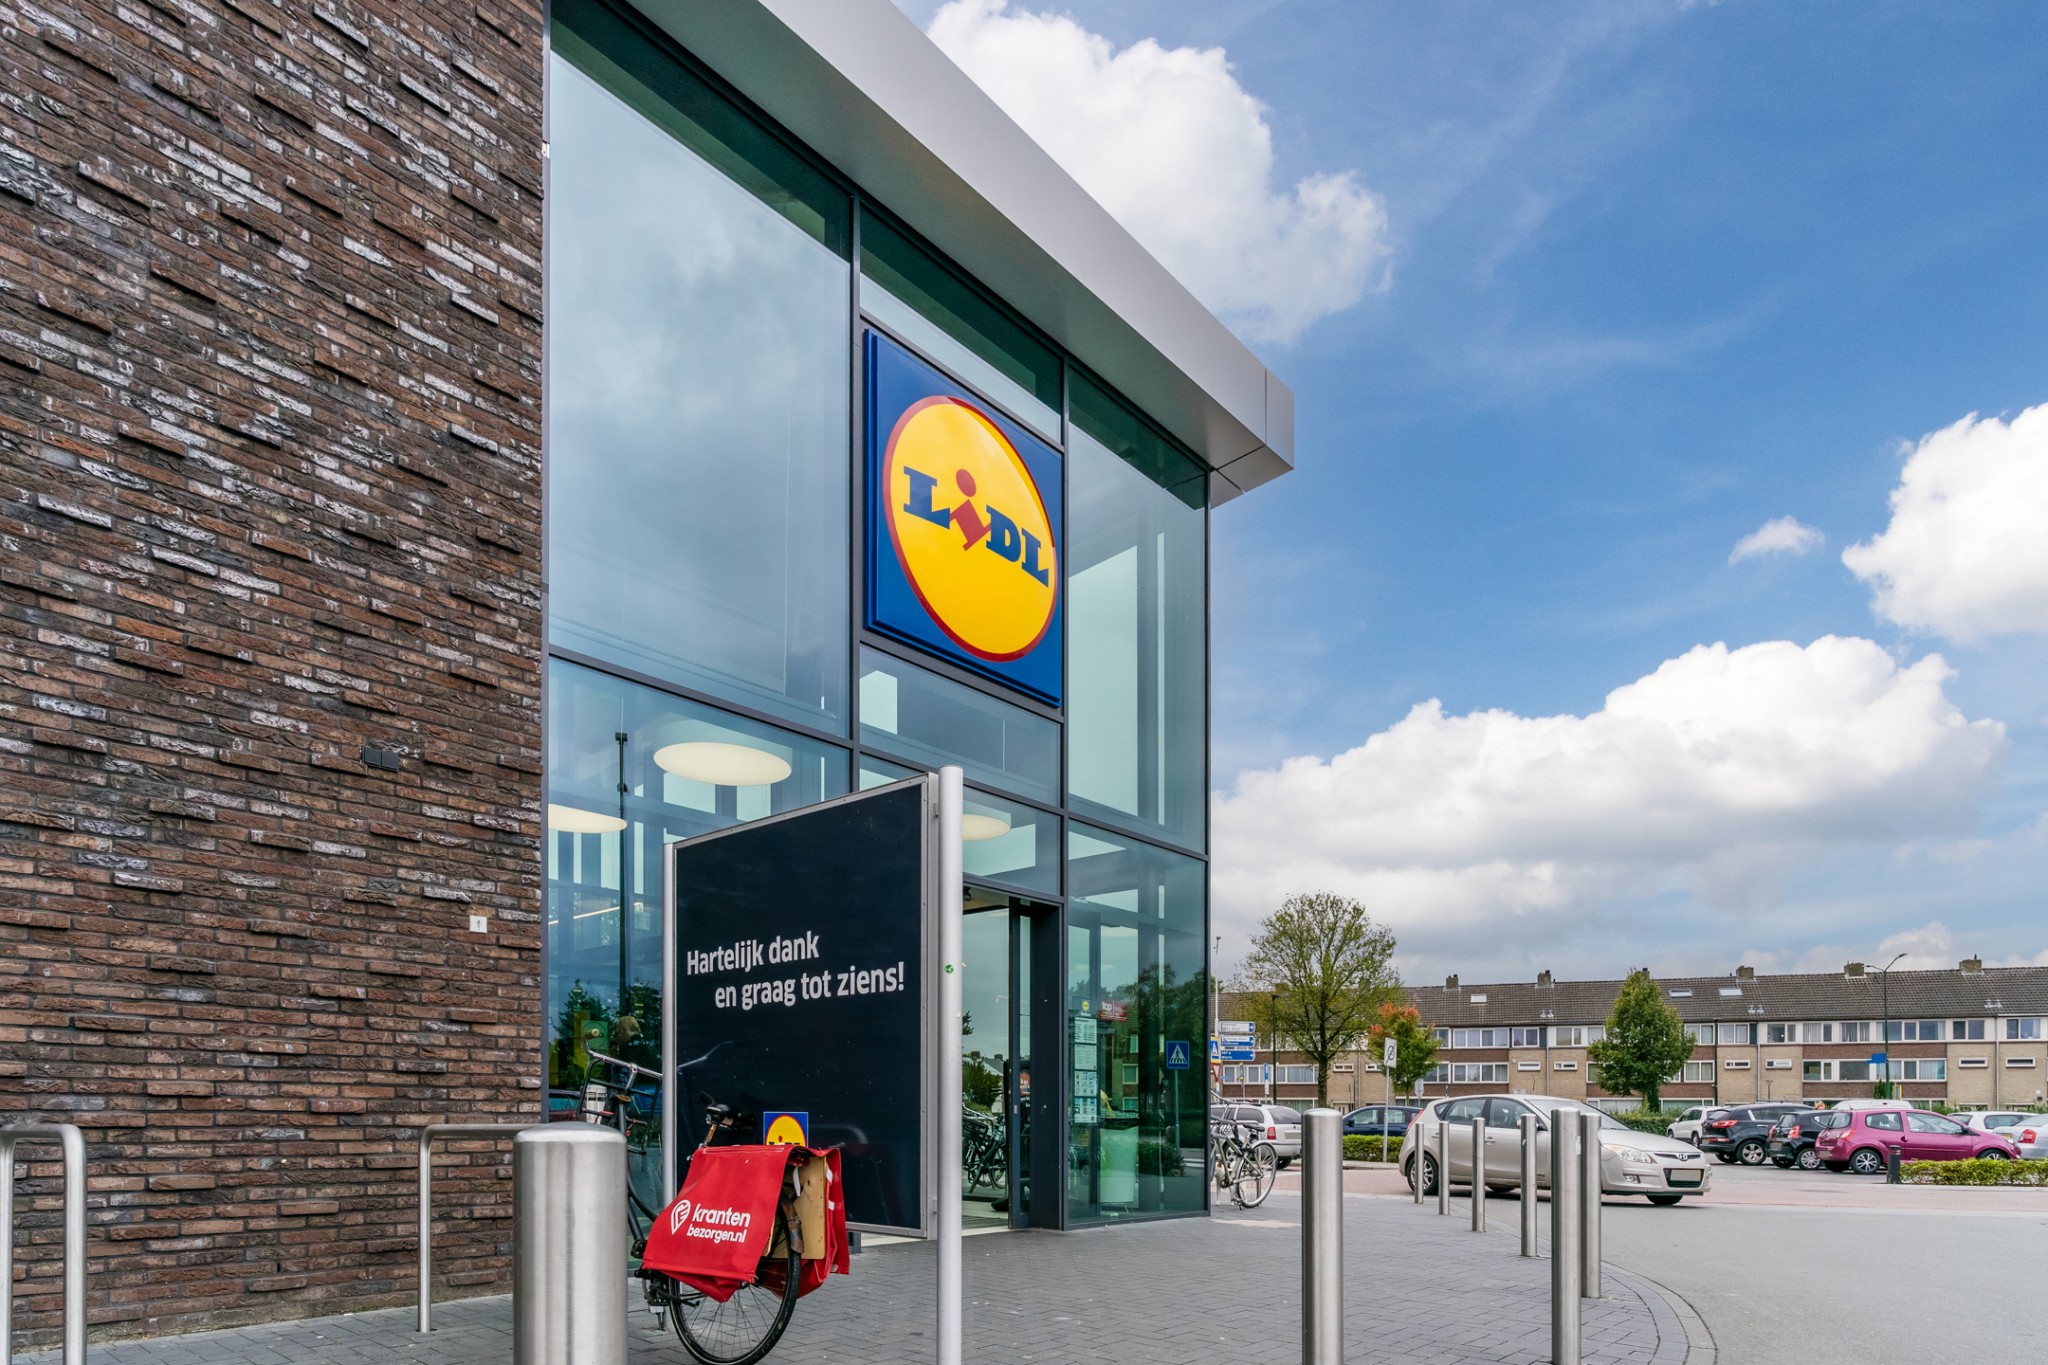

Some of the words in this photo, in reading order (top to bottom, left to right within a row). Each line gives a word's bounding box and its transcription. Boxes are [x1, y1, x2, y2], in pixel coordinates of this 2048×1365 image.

[687, 939, 765, 976] Hartelijk
[768, 930, 820, 964] dank
[715, 985, 737, 1009] en
[741, 978, 796, 1011] graag
[801, 970, 832, 1000] tot
[836, 961, 905, 997] ziens!
[692, 1203, 751, 1228] kranten
[686, 1223, 748, 1244] bezorgen.nl
